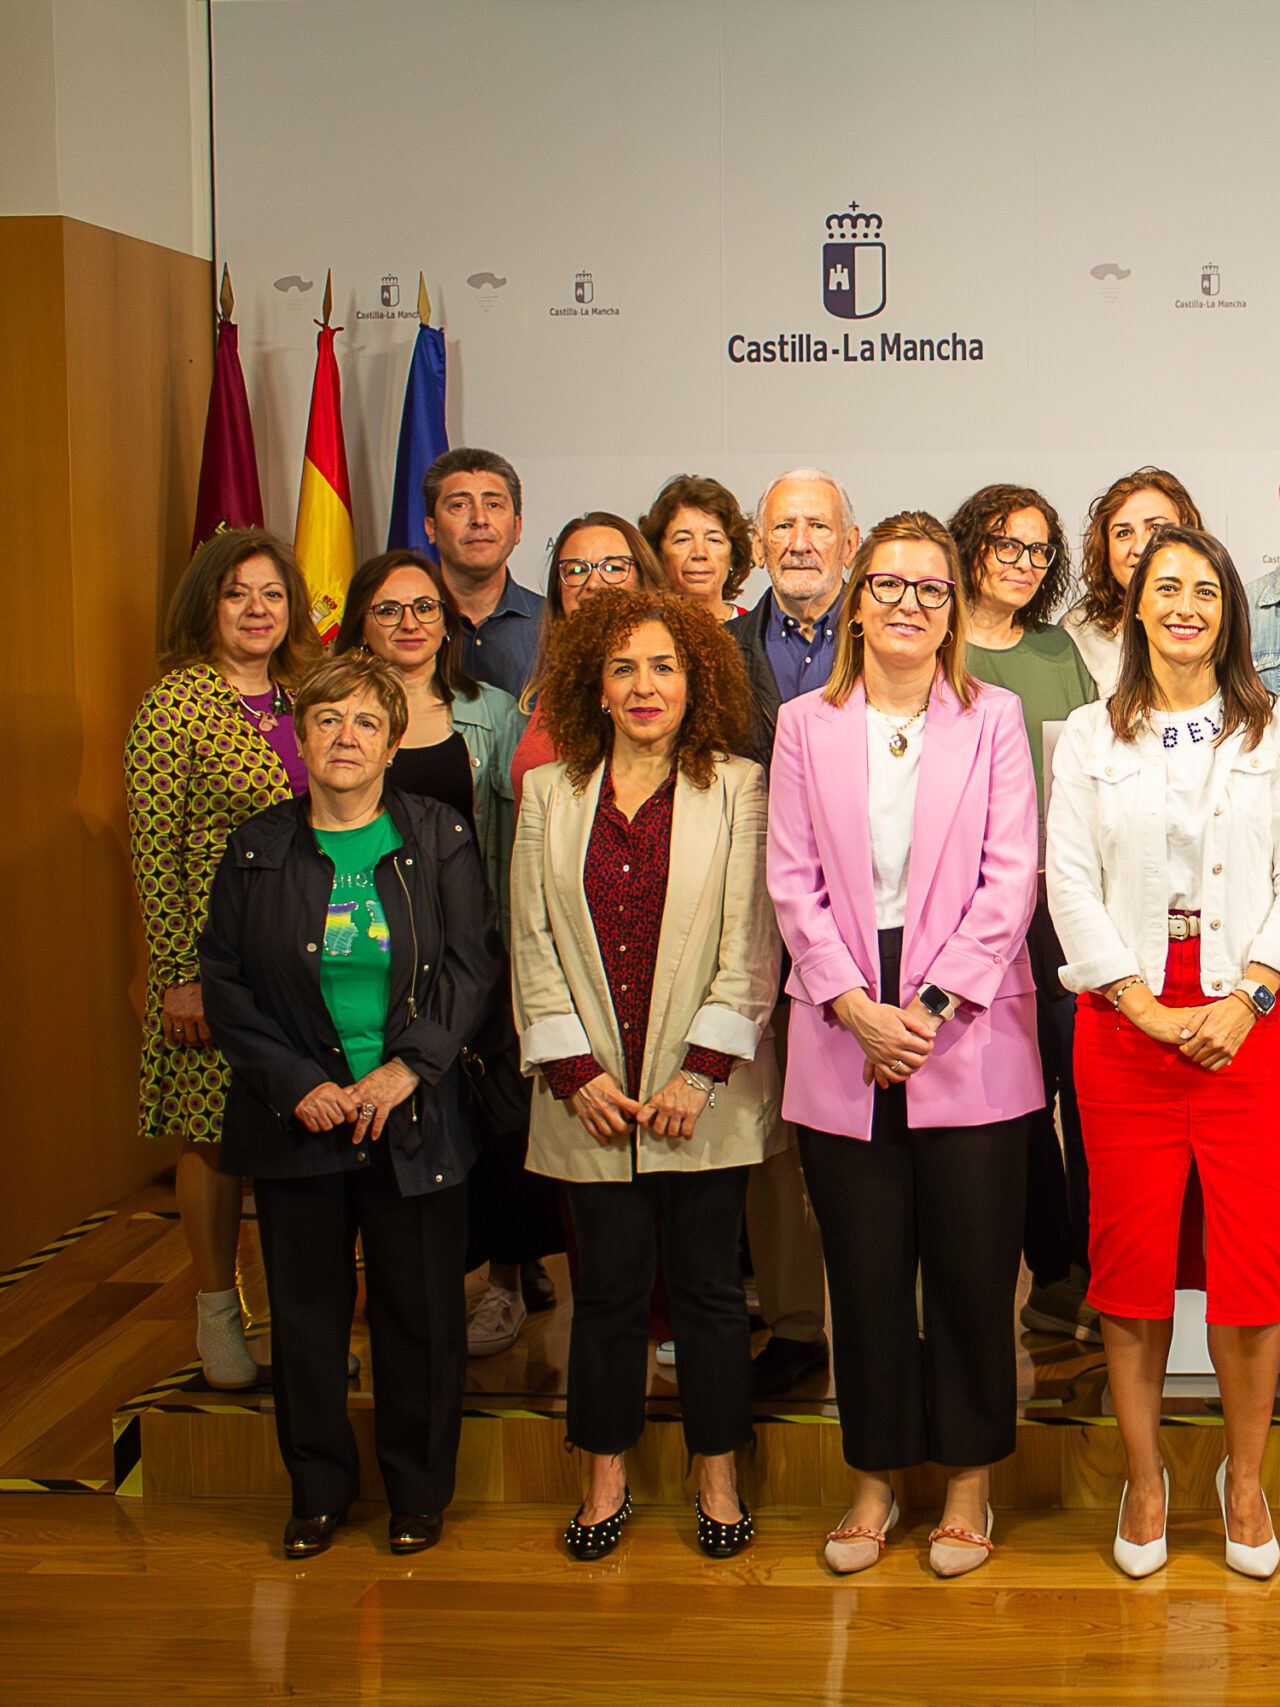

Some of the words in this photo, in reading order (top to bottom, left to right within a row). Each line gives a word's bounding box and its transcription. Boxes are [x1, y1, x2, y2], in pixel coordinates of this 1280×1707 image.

[1218, 299, 1247, 308] Mancha
[397, 310, 419, 319] Manc
[591, 307, 620, 316] Mancha
[728, 334, 875, 363] Castilla-La
[880, 332, 984, 361] Mancha
